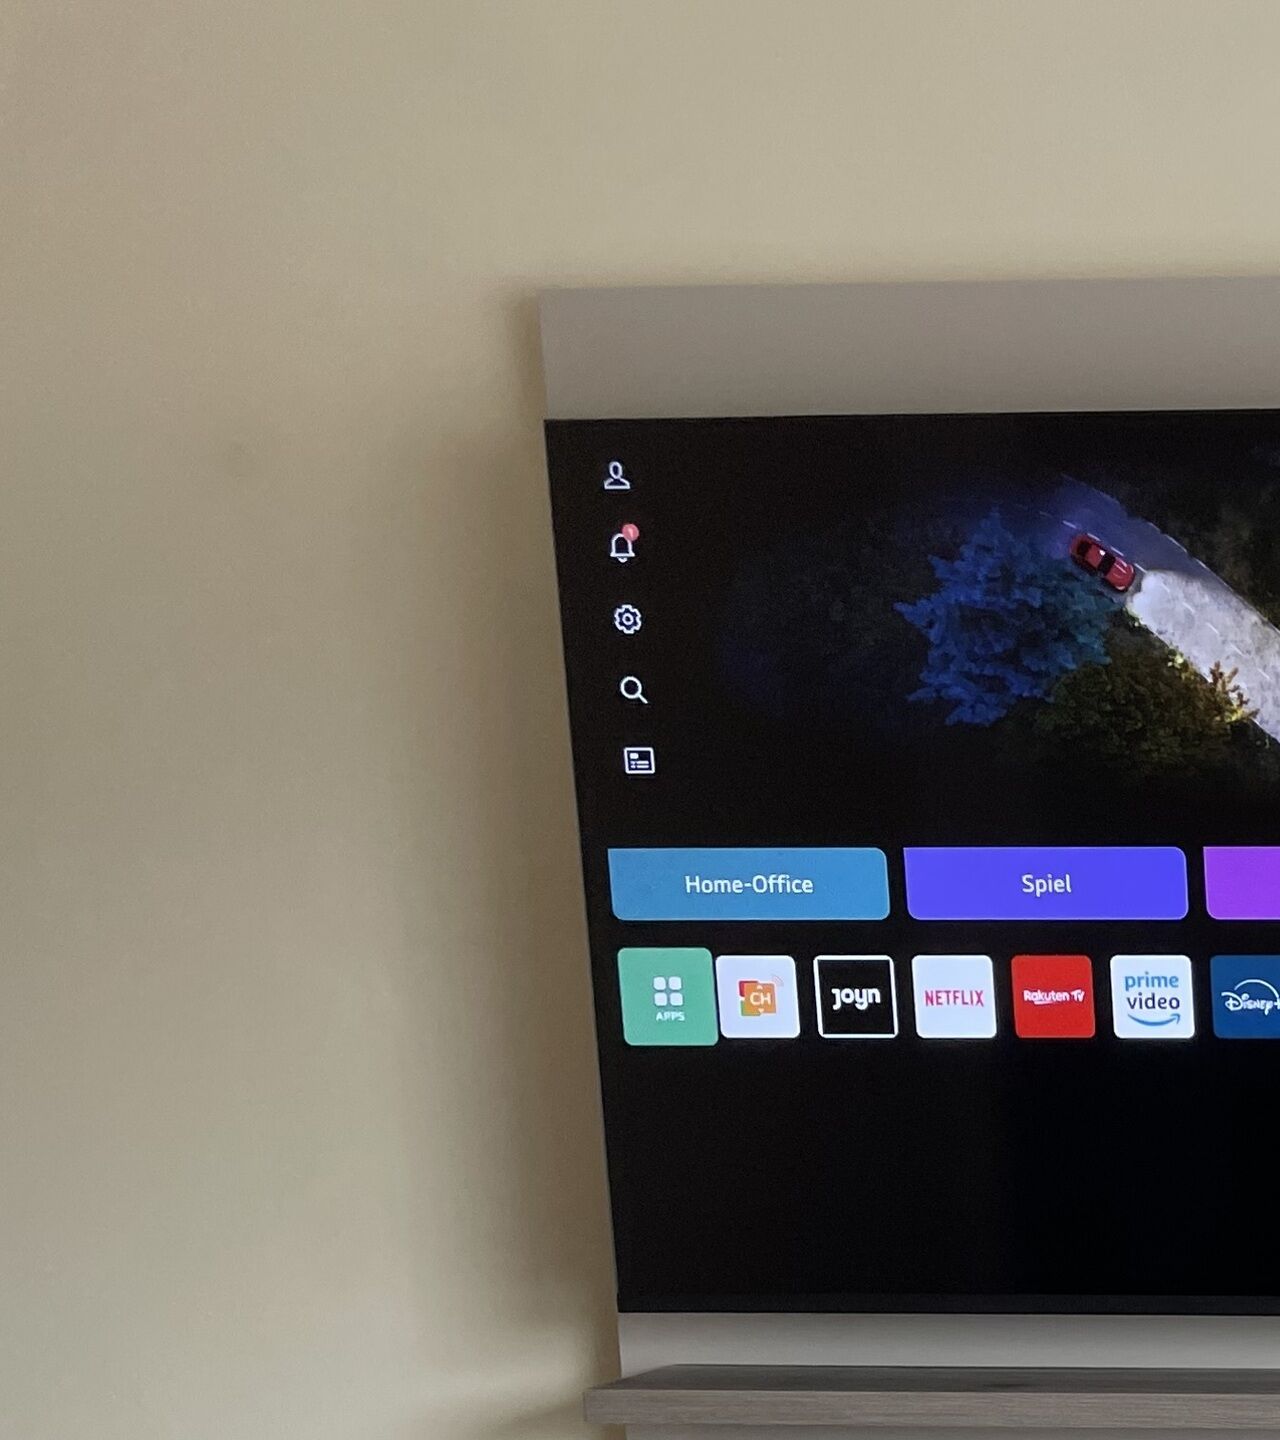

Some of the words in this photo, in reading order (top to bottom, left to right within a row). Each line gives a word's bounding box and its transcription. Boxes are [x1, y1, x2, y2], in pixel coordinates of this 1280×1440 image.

[684, 874, 814, 894] Home-Office
[1021, 873, 1072, 897] Spiel
[1124, 971, 1180, 992] prime
[750, 991, 772, 1006] CH
[924, 989, 985, 1007] NETFLIX
[1023, 989, 1070, 1005] Rakuten
[1127, 993, 1181, 1010] video
[655, 1011, 686, 1022] APPS
